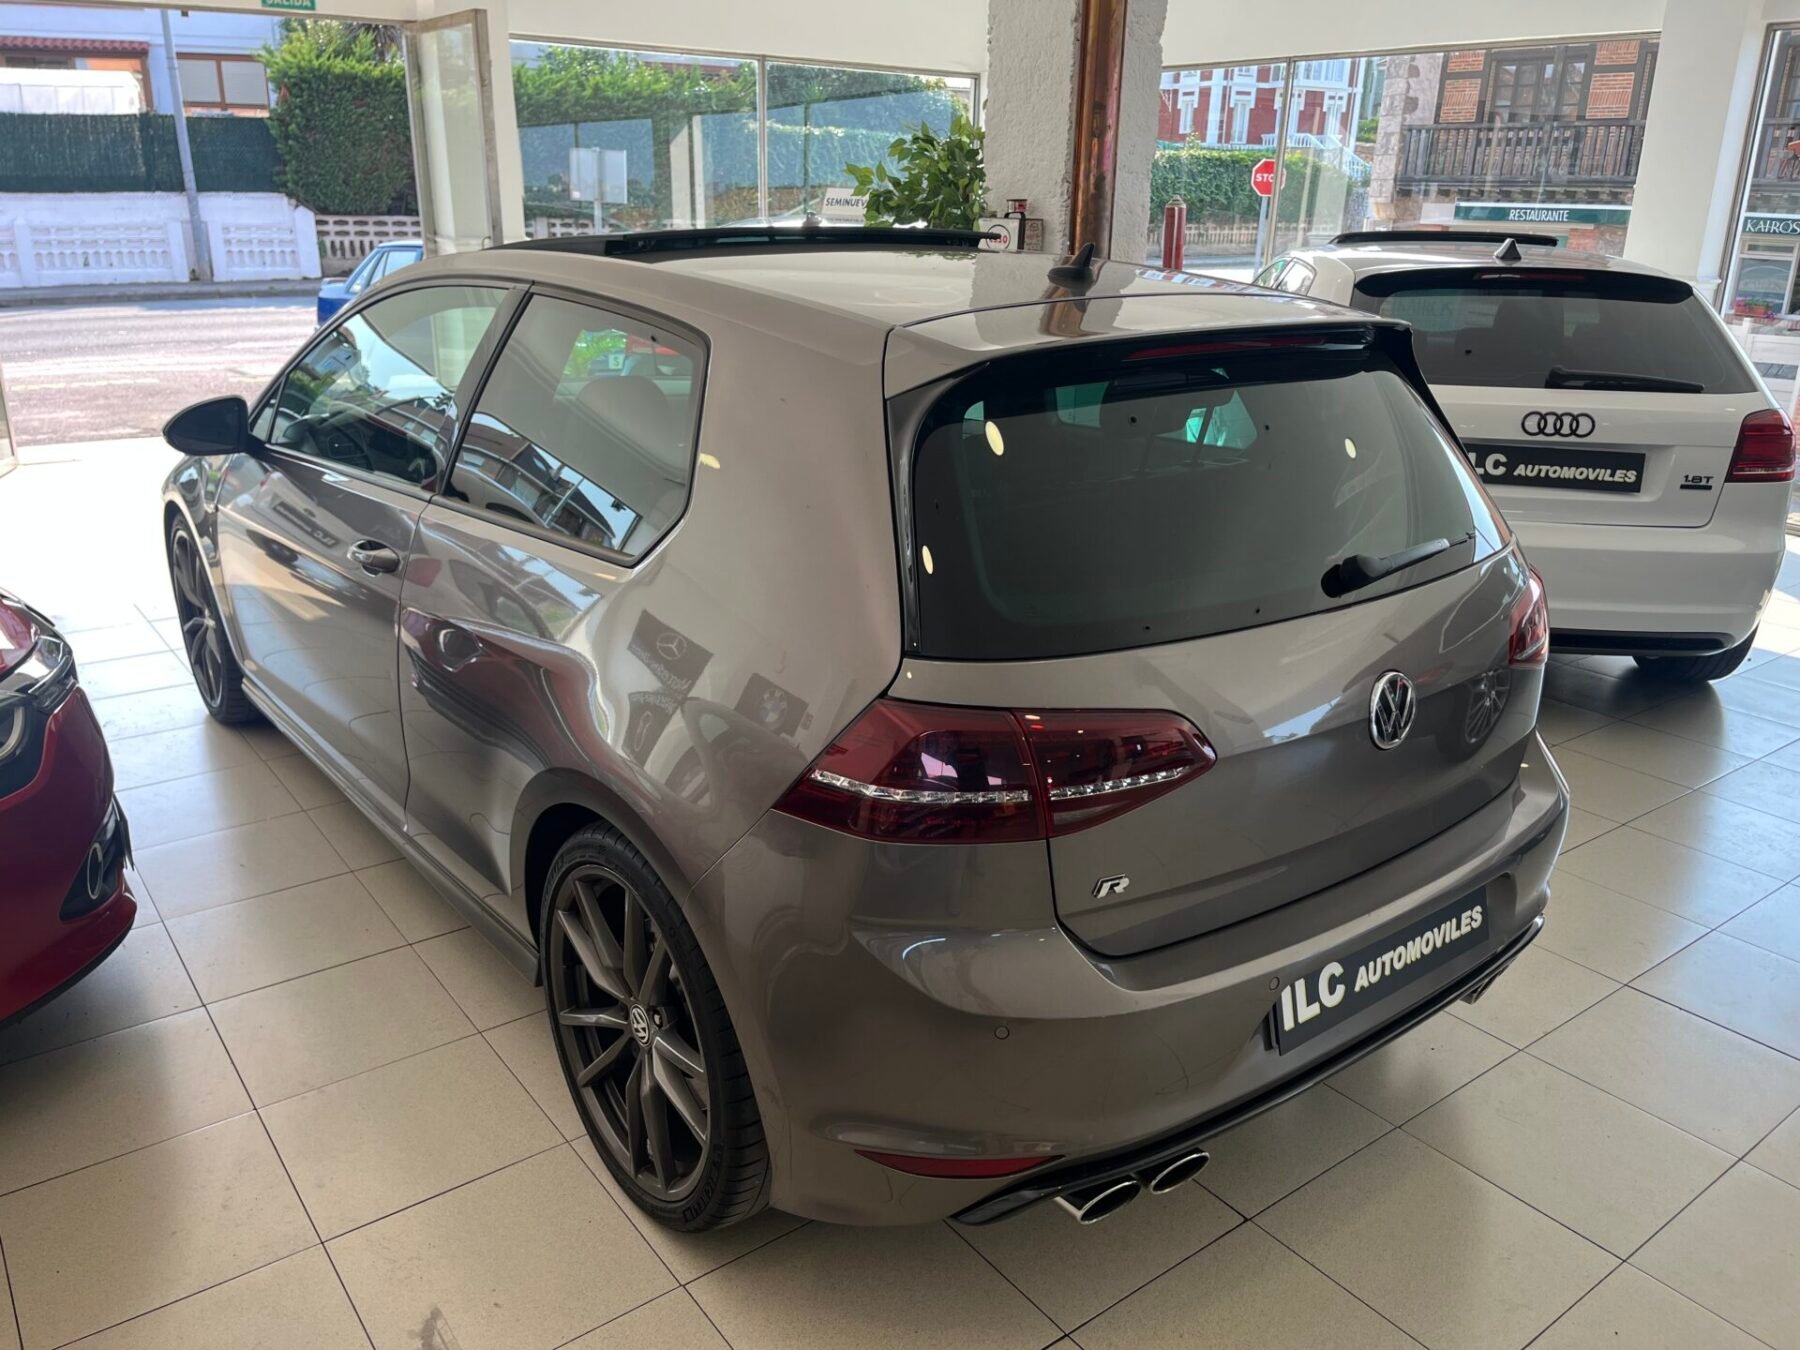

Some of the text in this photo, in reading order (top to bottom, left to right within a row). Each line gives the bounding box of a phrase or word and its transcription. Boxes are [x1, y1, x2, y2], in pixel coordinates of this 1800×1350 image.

[1255, 173, 1274, 182] STO
[825, 197, 868, 208] SEMINUEV
[1508, 209, 1570, 222] RESTAURANTE
[1468, 452, 1638, 484] LC AUTOMOVILES
[1091, 873, 1130, 899] R
[1281, 905, 1483, 1032] ILC AUTOMOVILES
